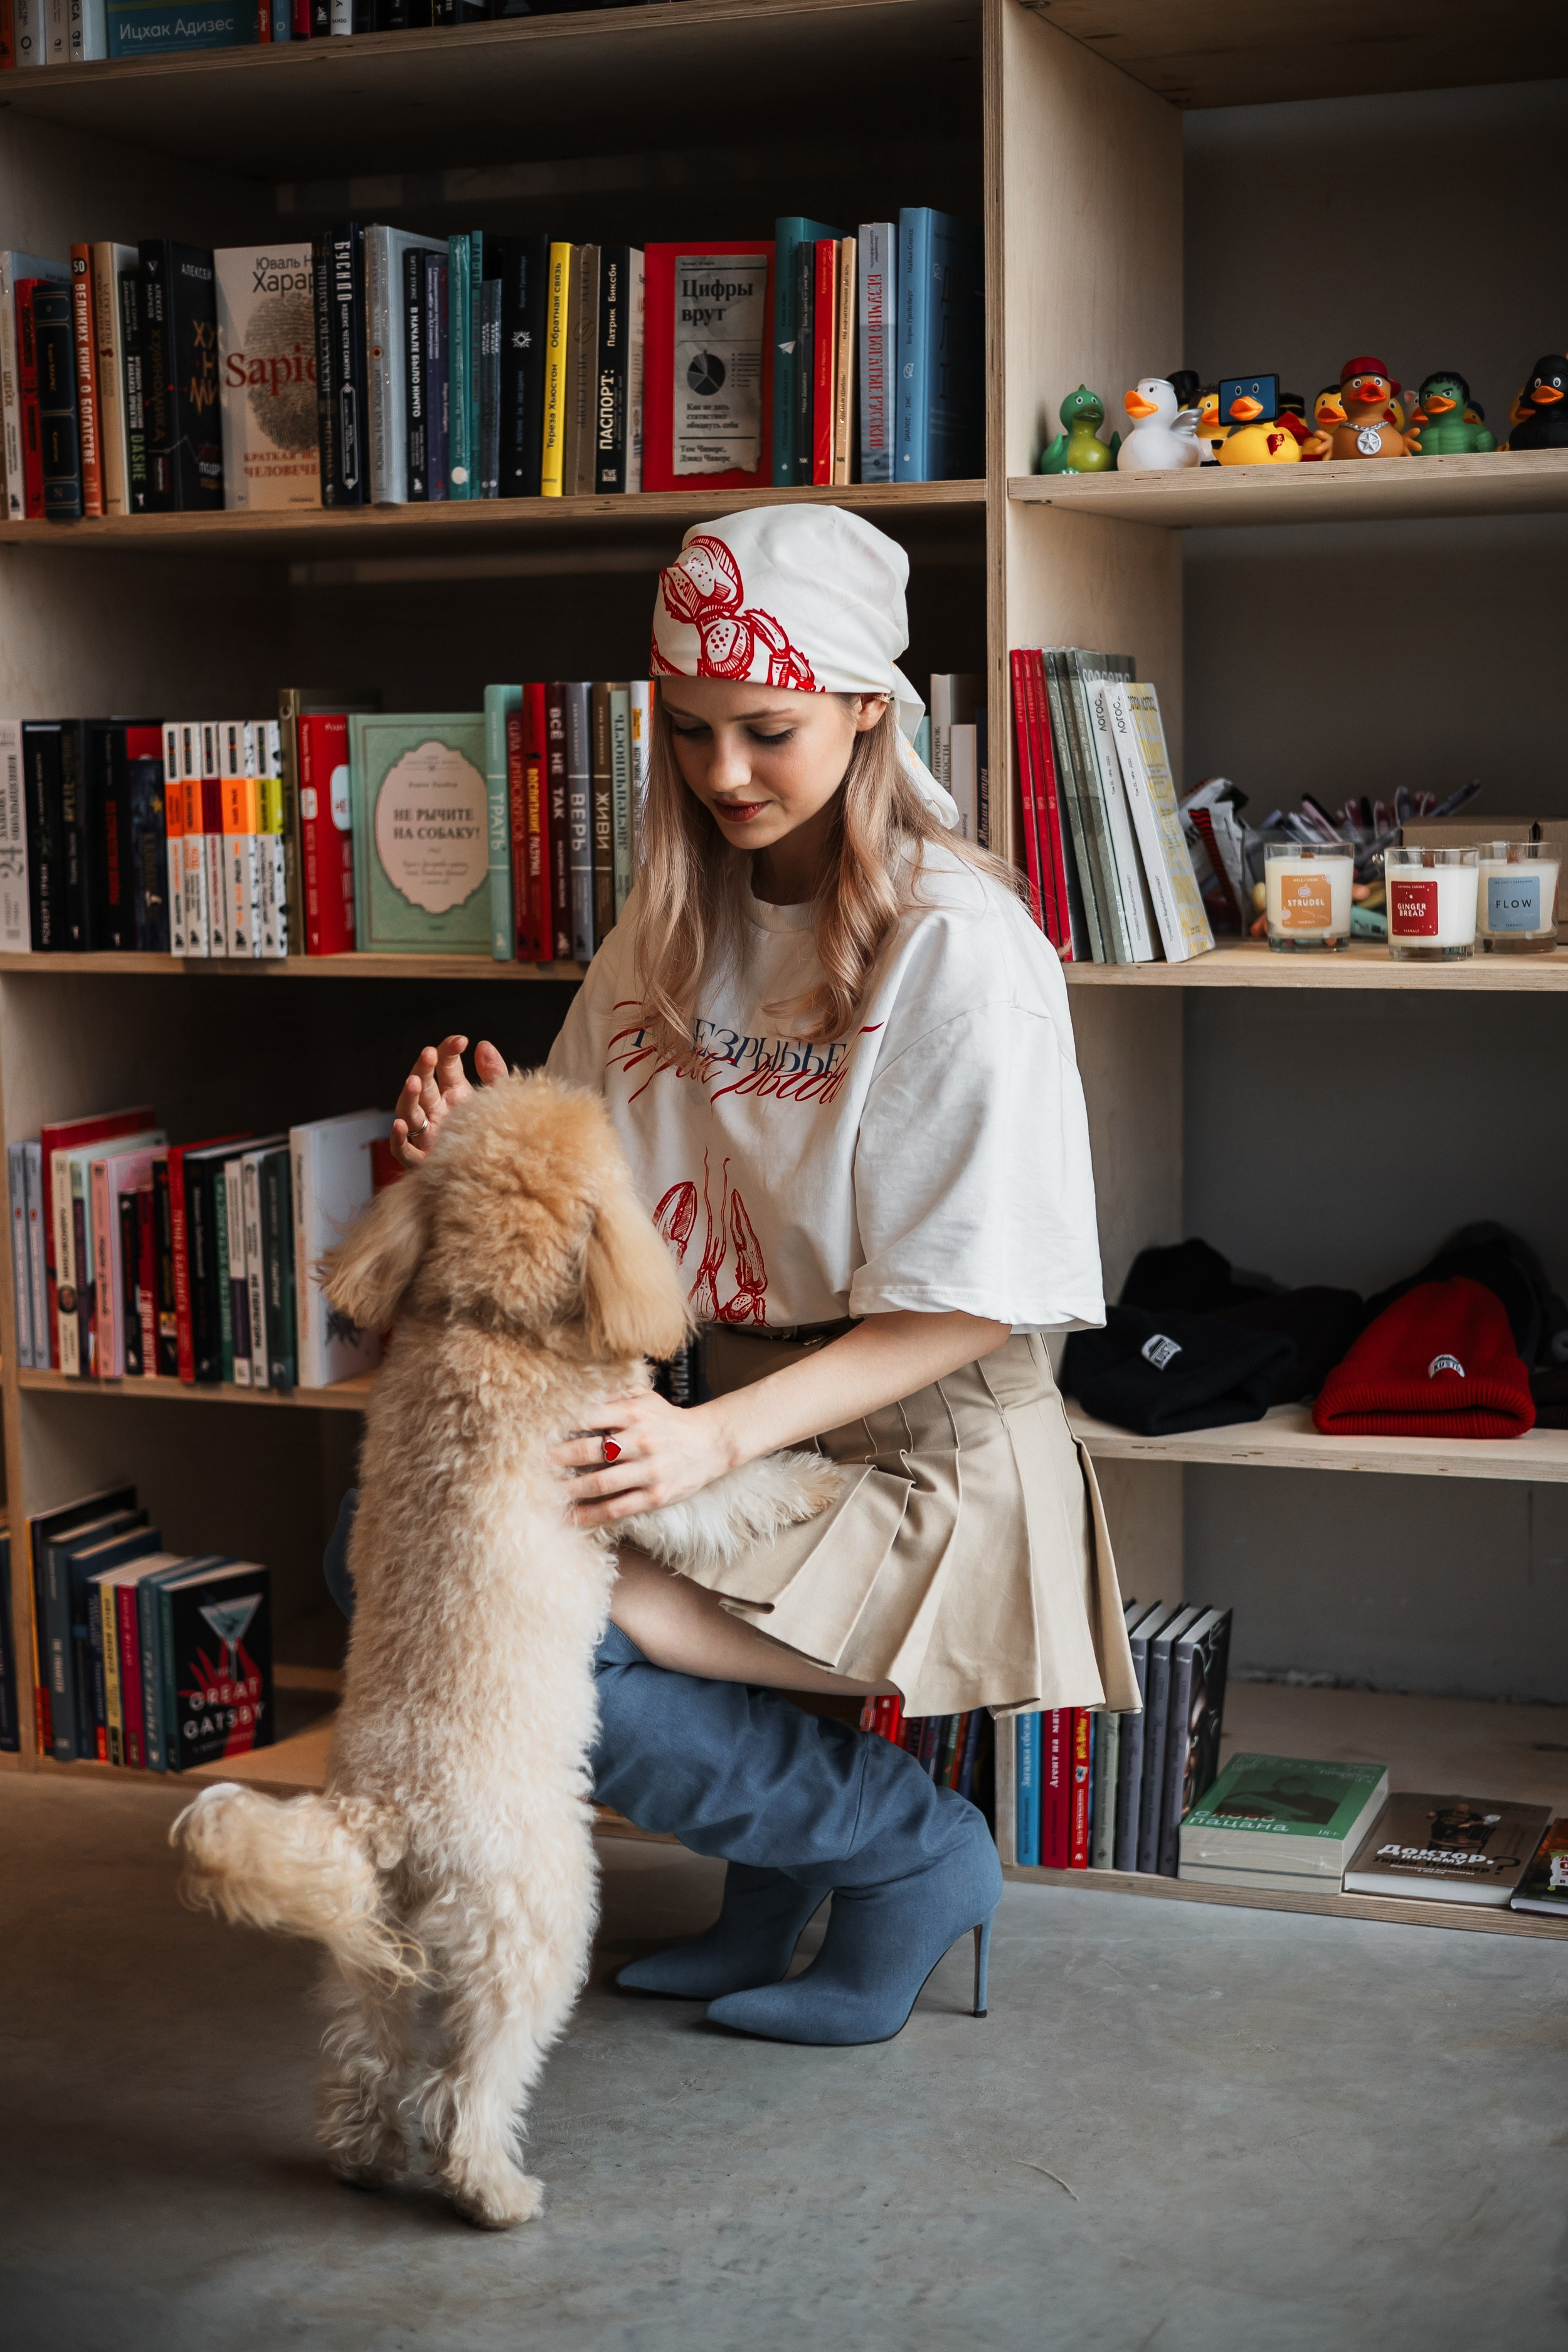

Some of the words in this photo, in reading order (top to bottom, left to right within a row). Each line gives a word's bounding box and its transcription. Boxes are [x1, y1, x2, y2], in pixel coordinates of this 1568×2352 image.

[120, 23, 171, 41] Ицхак
[175, 18, 235, 36] Адизес
[73, 260, 86, 273] 50
[255, 256, 300, 272] Юваль
[334, 241, 352, 302] БУСИДО
[553, 262, 563, 293] связь
[317, 265, 329, 312] ВОЙНЫ
[607, 263, 618, 301] Биксби
[681, 278, 753, 302] Цифры
[75, 283, 90, 342] ВЕЛИКИХ
[681, 308, 726, 327] врут
[867, 273, 882, 332] БЕЗУМНО
[906, 289, 914, 323] Гройсберг
[410, 314, 420, 354] НАЧАЛЕ
[550, 295, 561, 348] Обратная
[607, 307, 618, 347] Патрик
[78, 346, 91, 379] КНИГ
[319, 316, 331, 393] ИСКУССТВО
[411, 354, 421, 384] БЫЛО
[867, 334, 883, 393] БОГАТЫЕ
[411, 385, 421, 418] НИЧТО
[548, 363, 558, 410] Хьюстон
[599, 369, 615, 450] ПАСПОРТ:
[868, 395, 884, 450] РУССКИЕ
[81, 398, 95, 465] БОГАТСТВЕ
[546, 412, 558, 449] Тереза
[549, 707, 565, 740] ВСЁ
[551, 752, 564, 775] НЕ
[980, 767, 988, 801] утра
[393, 808, 412, 822] НЕ
[415, 807, 475, 822] РЫЧИТЕ
[489, 791, 505, 850] ТРАТЬ
[551, 787, 565, 820] ТАК
[595, 791, 610, 850] ЖИВИ
[393, 827, 415, 839] НА
[416, 826, 480, 840] СОБАКУ!
[569, 792, 588, 852] ВЕРЬ
[1287, 898, 1325, 908] STRUDEL
[1397, 903, 1427, 911] GINGER
[1495, 899, 1532, 909] FLOW
[690, 1017, 847, 1081] ЕЗРЫБЬЕ
[189, 1676, 258, 1712] GREAT
[183, 1700, 265, 1740] GATSBY
[1052, 1738, 1059, 1752] на
[1020, 1748, 1032, 1788] Загадка
[1049, 1754, 1060, 1788] Агент
[1189, 1816, 1289, 1832] пацана
[1194, 1809, 1275, 1824] слово
[1376, 1843, 1495, 1866] Доктор,
[1401, 1854, 1466, 1865] почему
